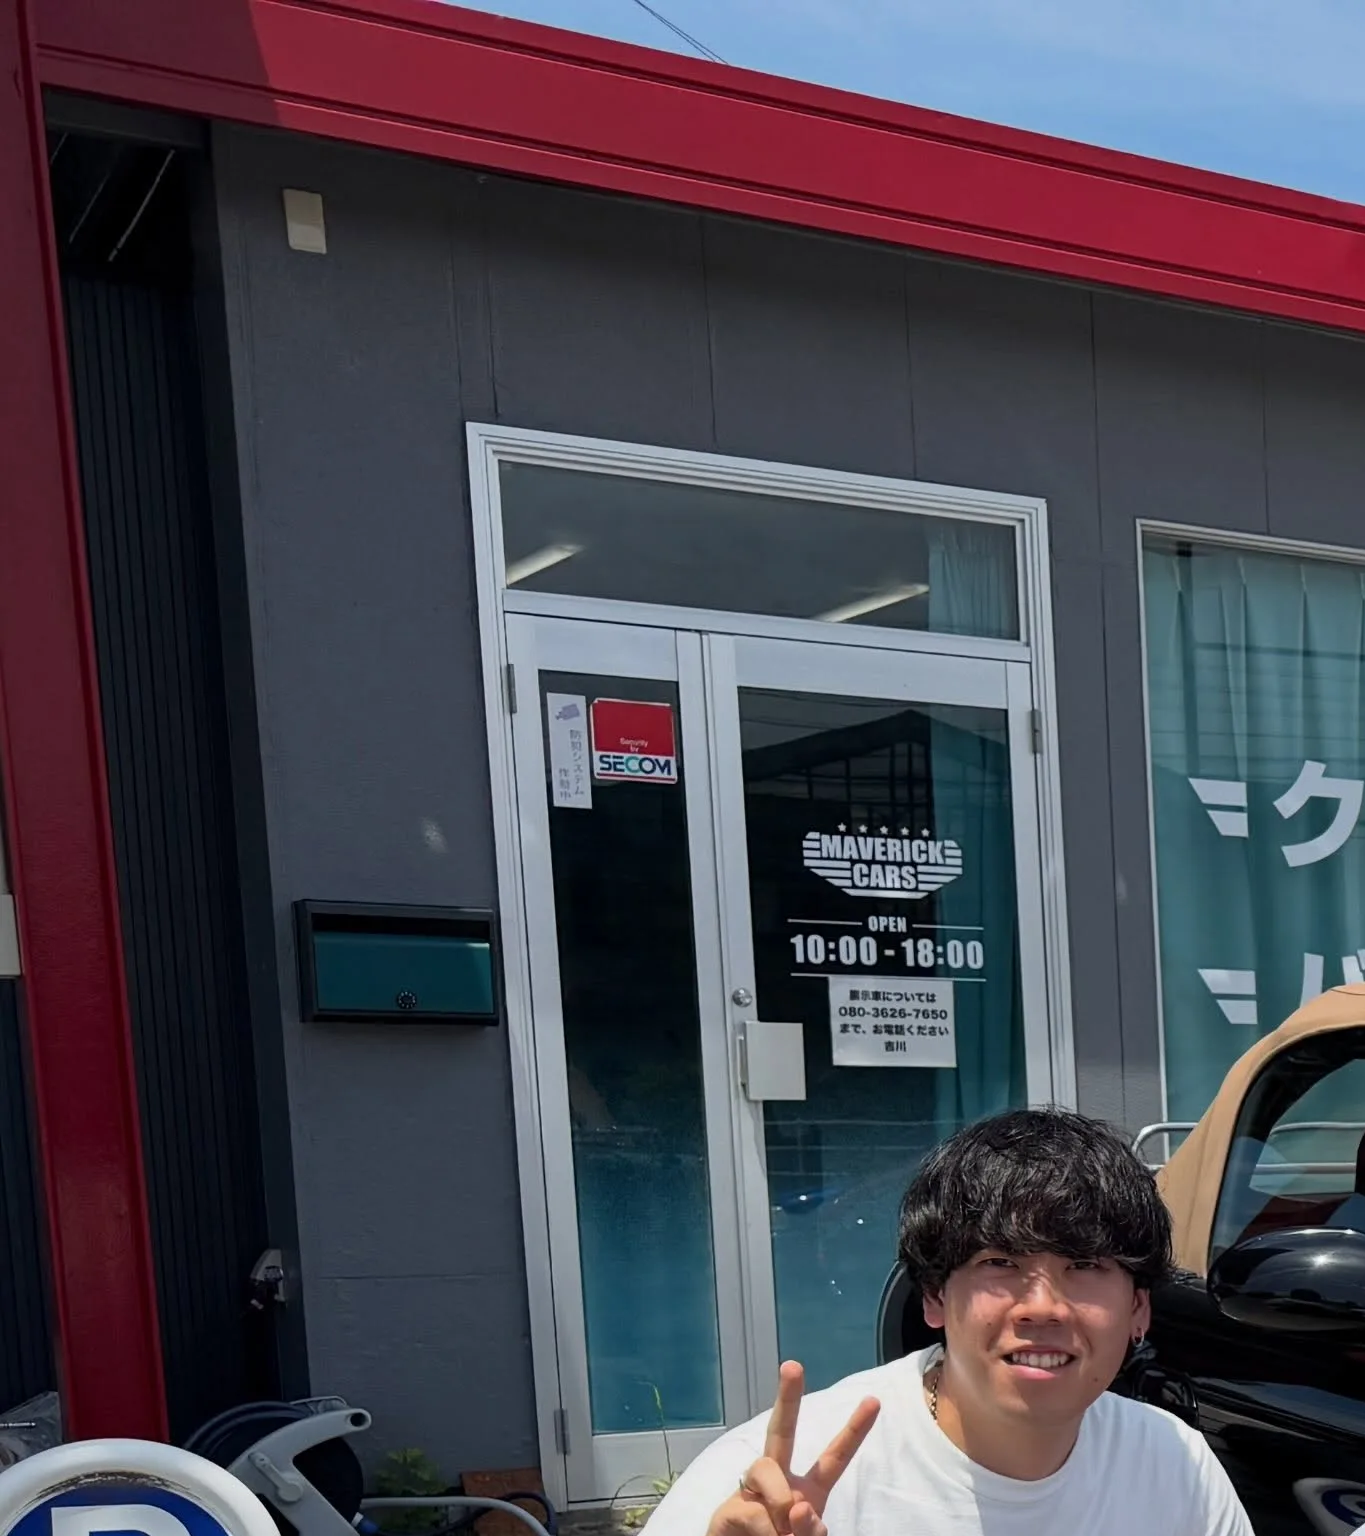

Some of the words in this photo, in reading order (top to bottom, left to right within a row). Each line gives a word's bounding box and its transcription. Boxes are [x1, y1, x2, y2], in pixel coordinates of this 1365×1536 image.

[599, 754, 672, 776] SECOM
[821, 834, 944, 865] MAVERICK
[853, 863, 917, 889] CARS
[868, 916, 907, 933] OPEN
[790, 934, 878, 966] 10:00
[901, 938, 984, 969] 18:00
[838, 1006, 948, 1020] 080-3626-7650
